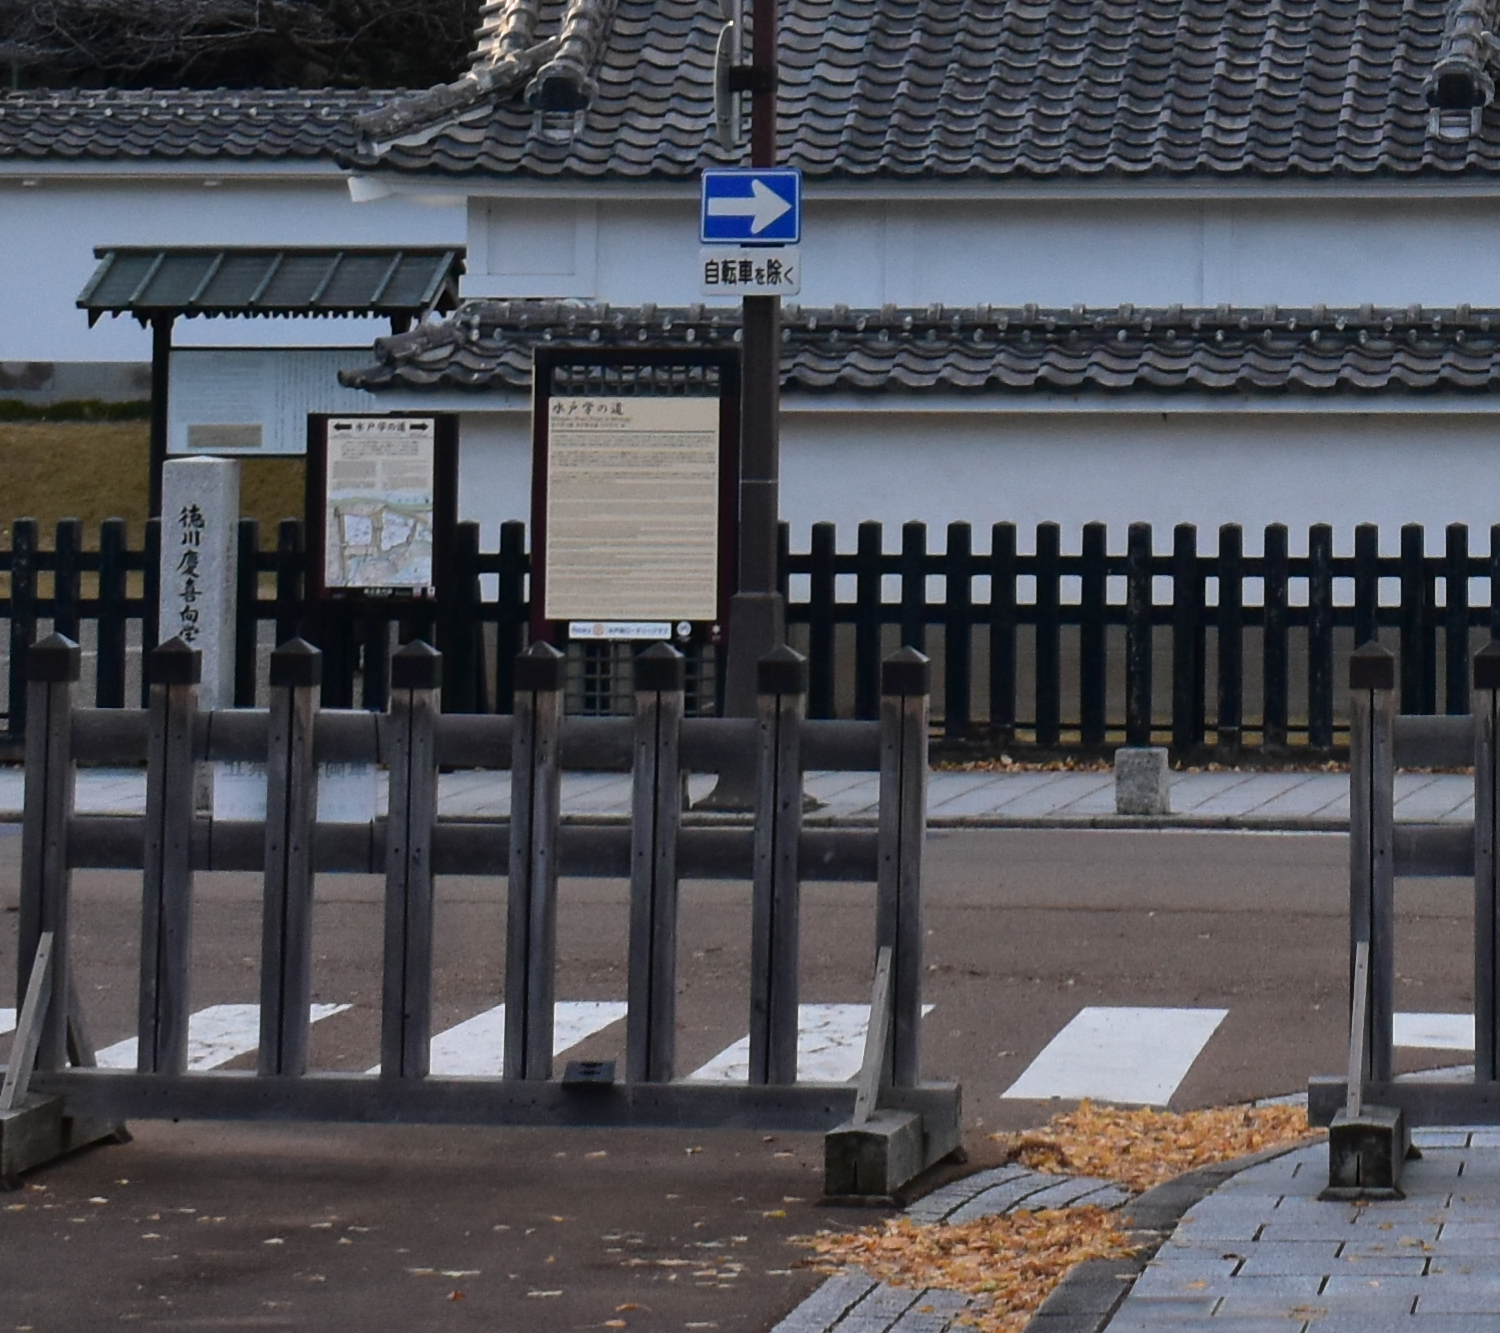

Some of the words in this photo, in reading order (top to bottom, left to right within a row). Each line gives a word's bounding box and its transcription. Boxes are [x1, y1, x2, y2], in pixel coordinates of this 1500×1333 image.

[705, 259, 794, 285] 自転車を除く
[552, 401, 625, 416] 水戸学の道
[355, 422, 406, 432] 水戸学の道
